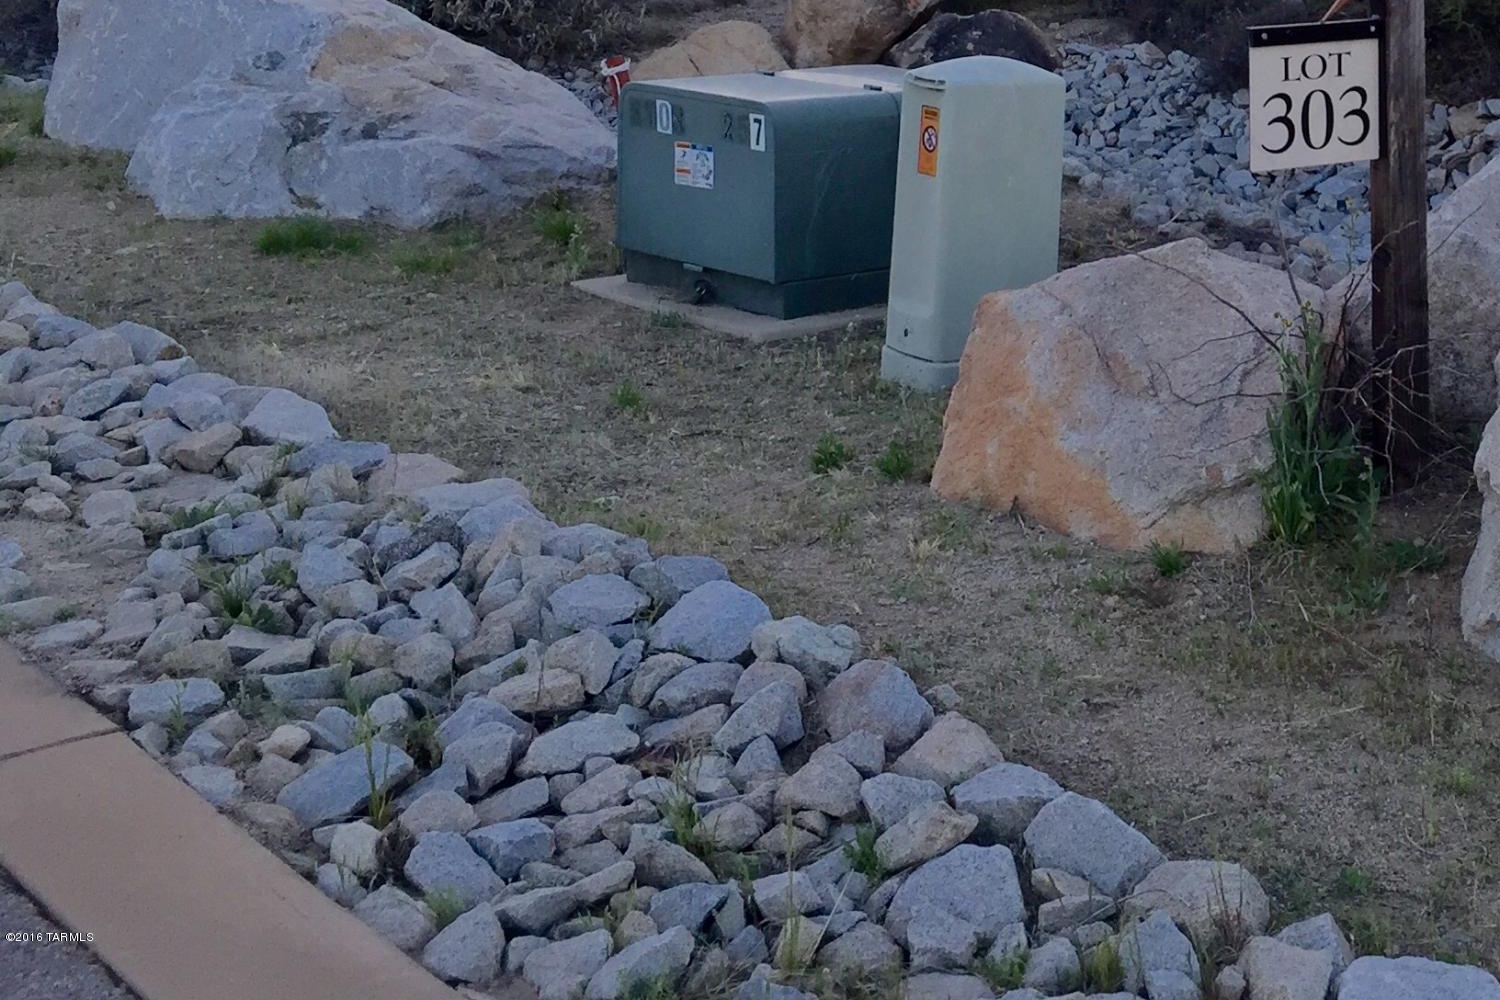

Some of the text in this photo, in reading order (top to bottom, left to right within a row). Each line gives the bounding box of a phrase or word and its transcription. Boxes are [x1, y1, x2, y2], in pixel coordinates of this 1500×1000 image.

[1280, 51, 1351, 82] LOT
[752, 117, 763, 147] 7
[1261, 85, 1371, 154] 303
